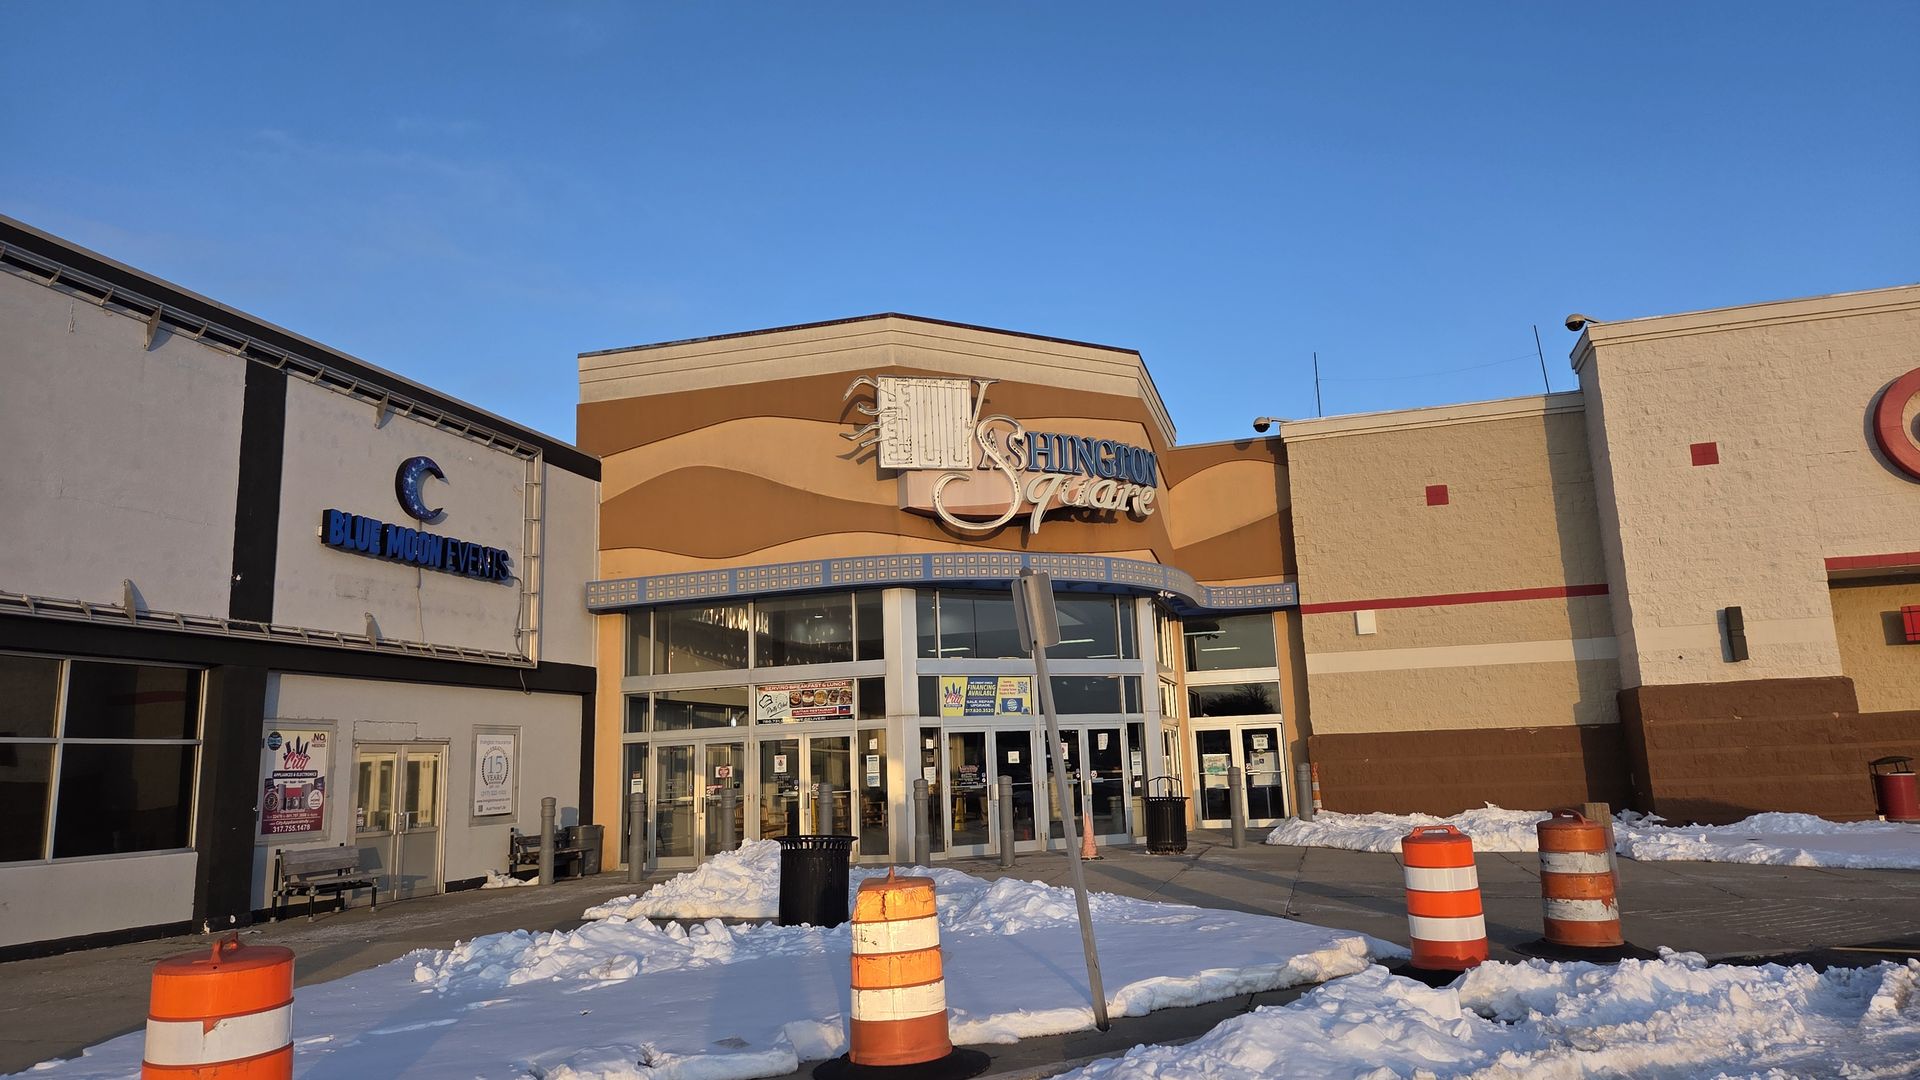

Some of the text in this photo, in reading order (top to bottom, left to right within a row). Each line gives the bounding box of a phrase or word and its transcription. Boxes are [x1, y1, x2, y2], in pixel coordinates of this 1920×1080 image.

[932, 415, 1156, 534] Square
[326, 509, 511, 580] BLUE MOON EVENTS
[789, 682, 821, 690] BREAKFAST
[313, 733, 326, 741] NO
[284, 751, 310, 771] City
[487, 755, 503, 774] 15
[486, 774, 503, 782] YEARS
